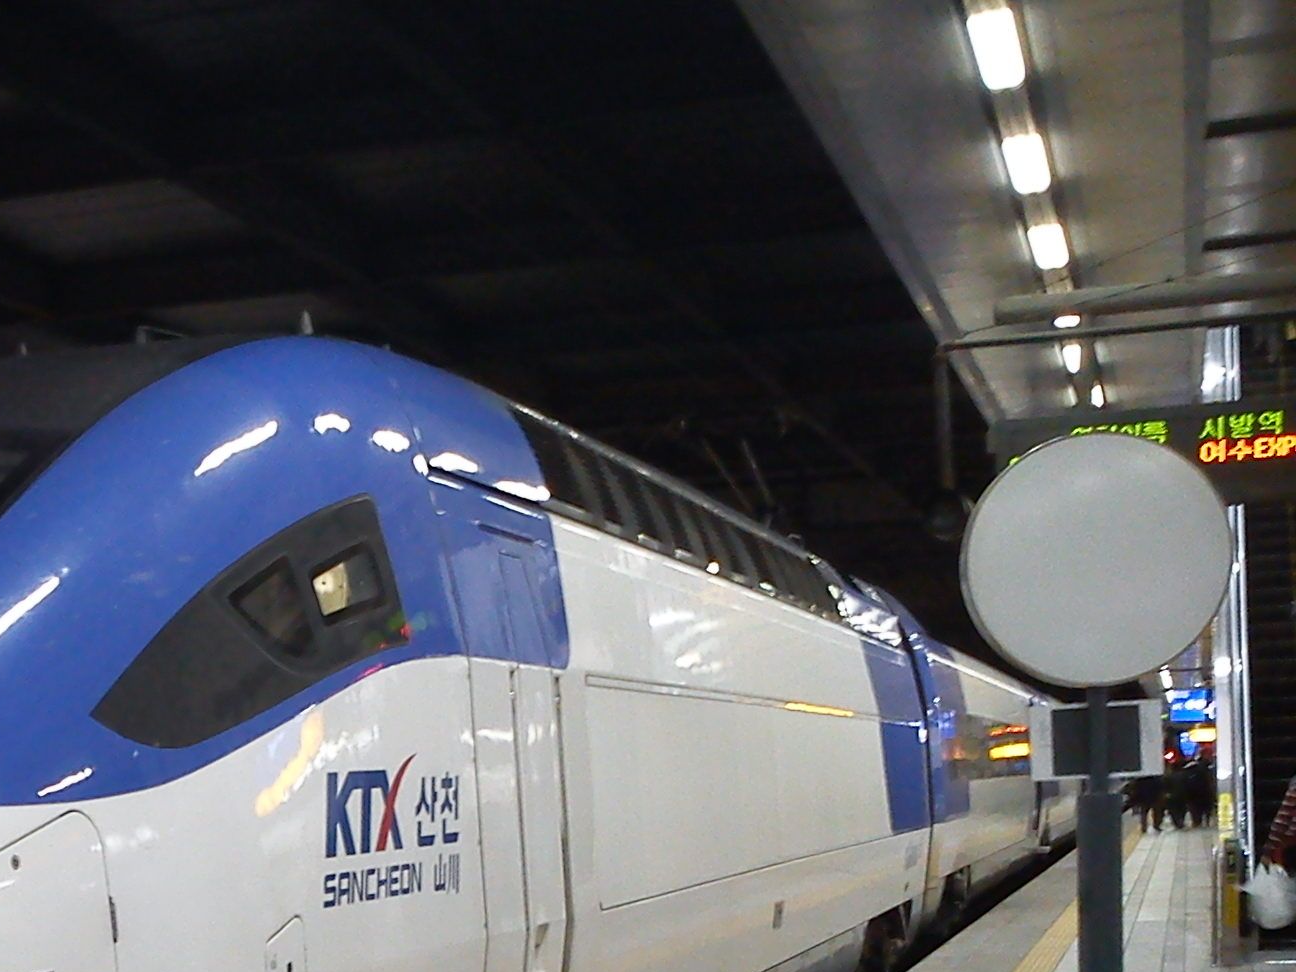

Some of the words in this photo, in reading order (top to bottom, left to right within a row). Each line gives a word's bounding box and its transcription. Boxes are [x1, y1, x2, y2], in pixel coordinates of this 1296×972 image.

[1199, 411, 1284, 440] 시발역
[325, 753, 416, 858] KTX
[416, 772, 459, 847] 산천
[323, 862, 422, 908] SANCHEON
[434, 853, 459, 893] 山川
